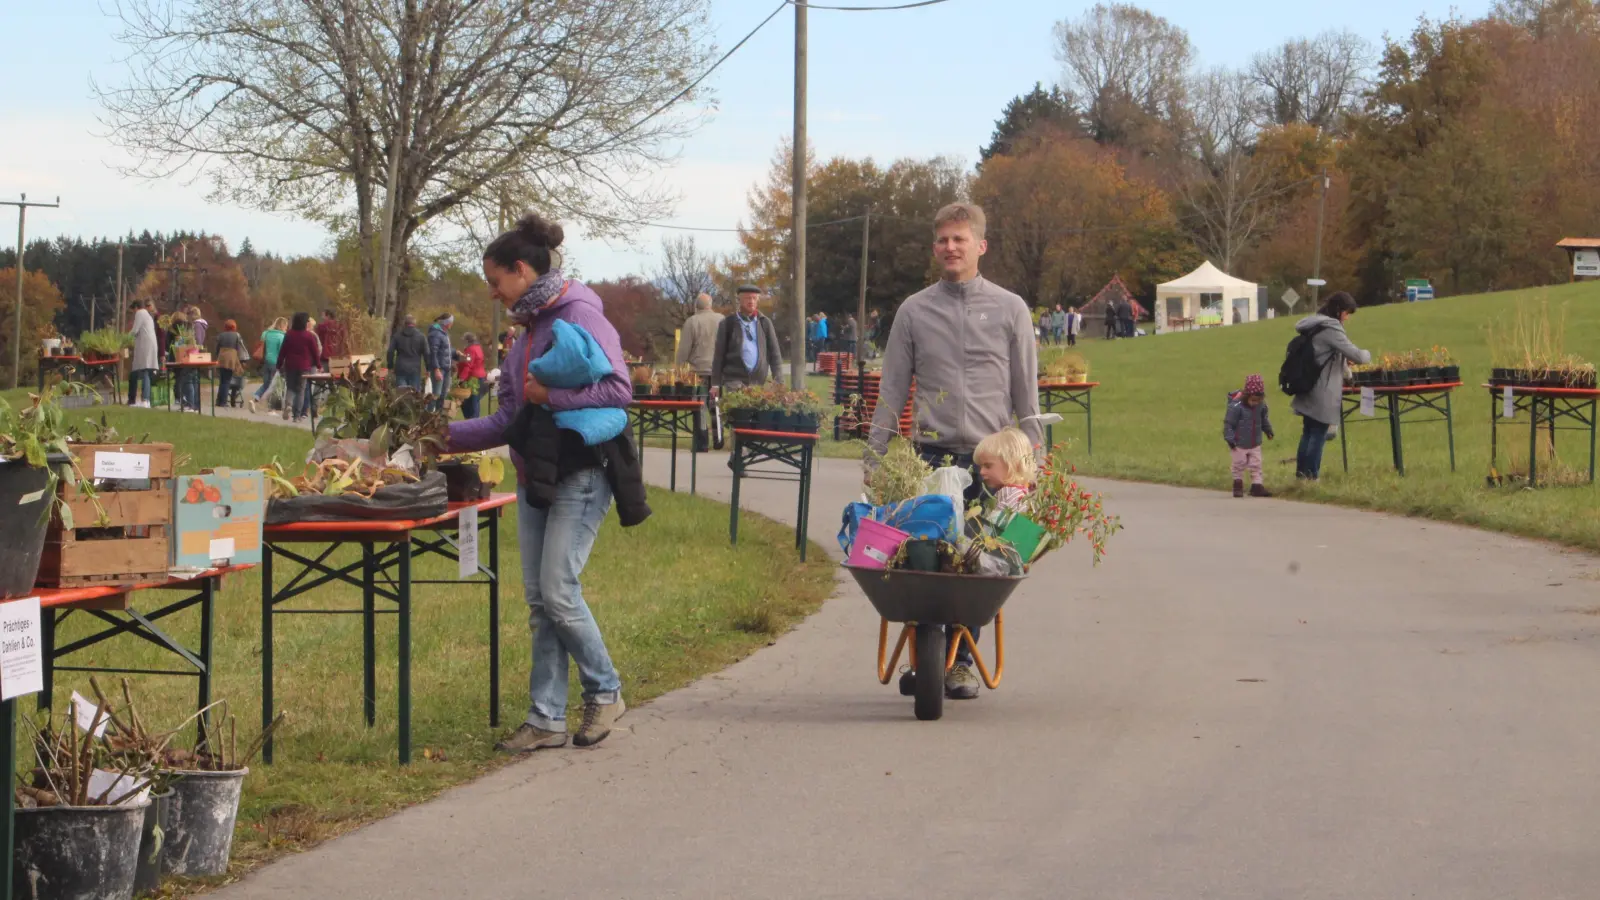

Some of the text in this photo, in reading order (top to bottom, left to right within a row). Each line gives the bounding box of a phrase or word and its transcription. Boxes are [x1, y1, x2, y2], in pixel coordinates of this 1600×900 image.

[2, 636, 35, 654] Dahlien & Co.
